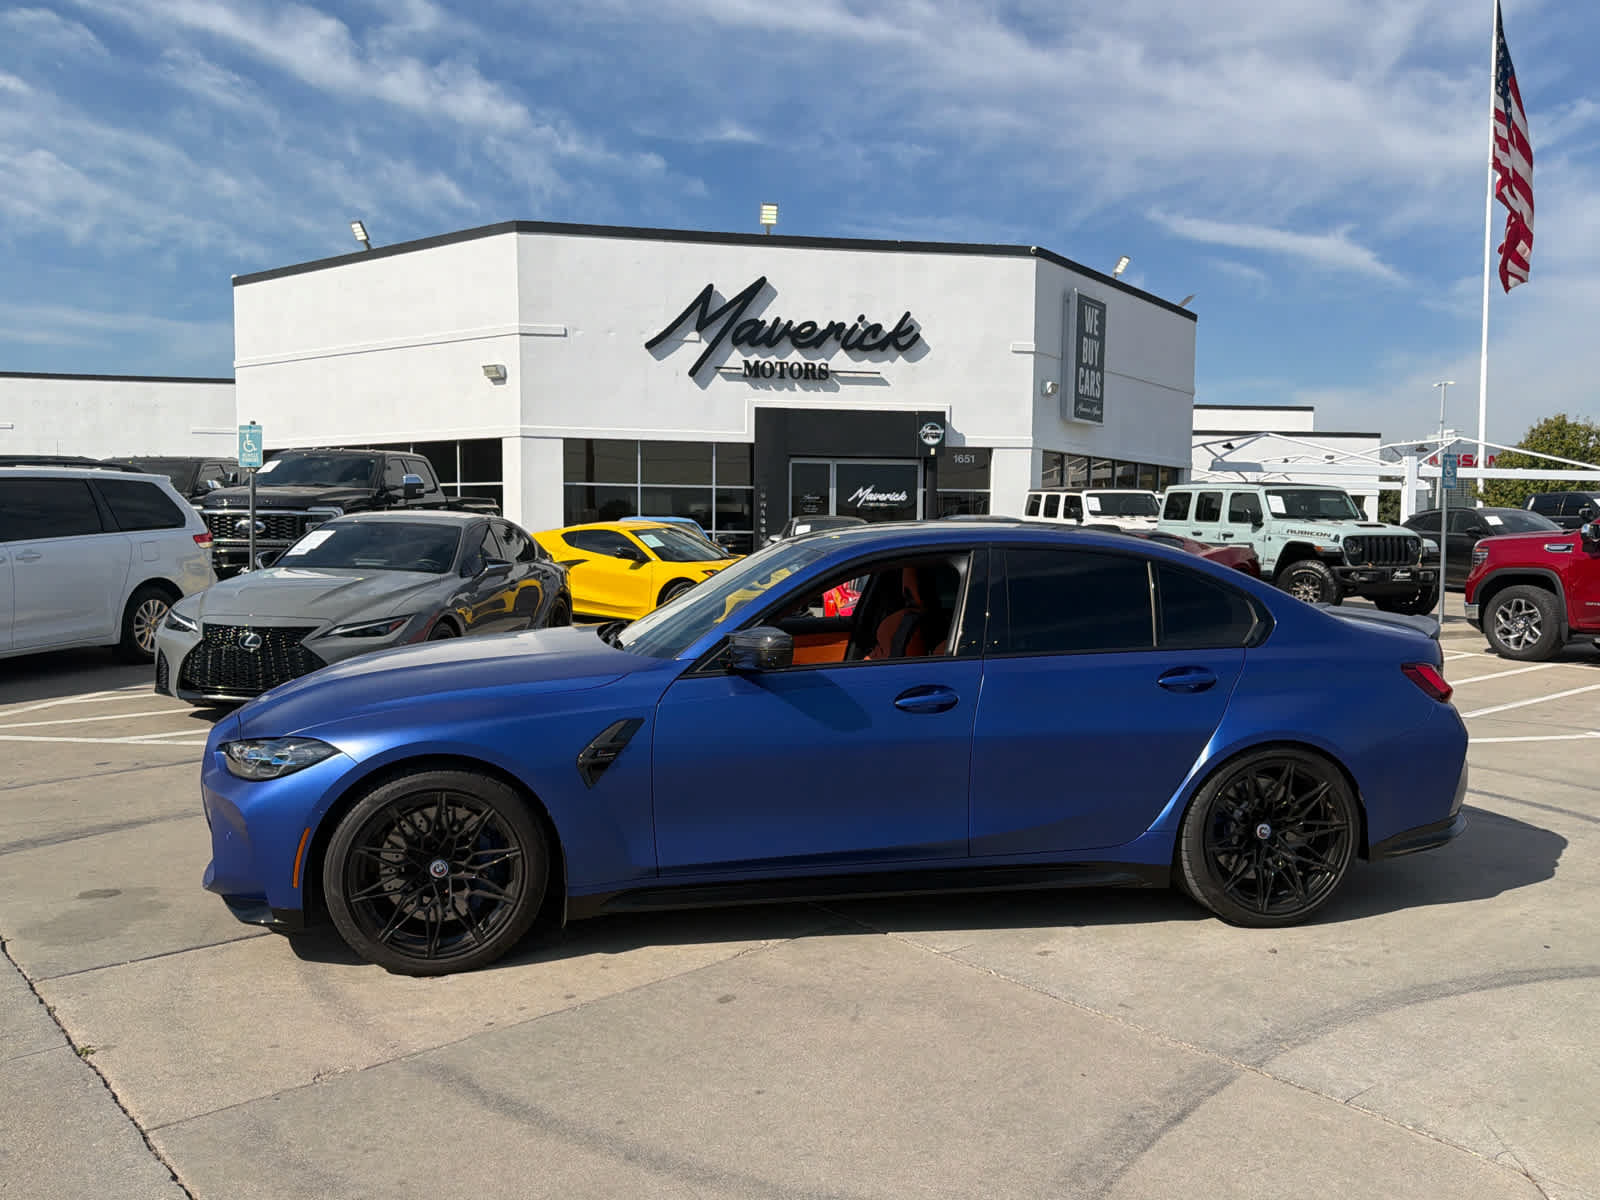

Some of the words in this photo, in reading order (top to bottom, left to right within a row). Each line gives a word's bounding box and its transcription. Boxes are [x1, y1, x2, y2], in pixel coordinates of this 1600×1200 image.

[645, 276, 920, 378] Maverick
[1084, 304, 1099, 336] WE
[1082, 336, 1099, 367] BUY
[742, 360, 830, 381] MOTORS
[1079, 367, 1101, 399] CARS
[953, 454, 976, 464] 1651
[847, 484, 908, 508] Maverick
[1286, 528, 1332, 538] RUBICON
